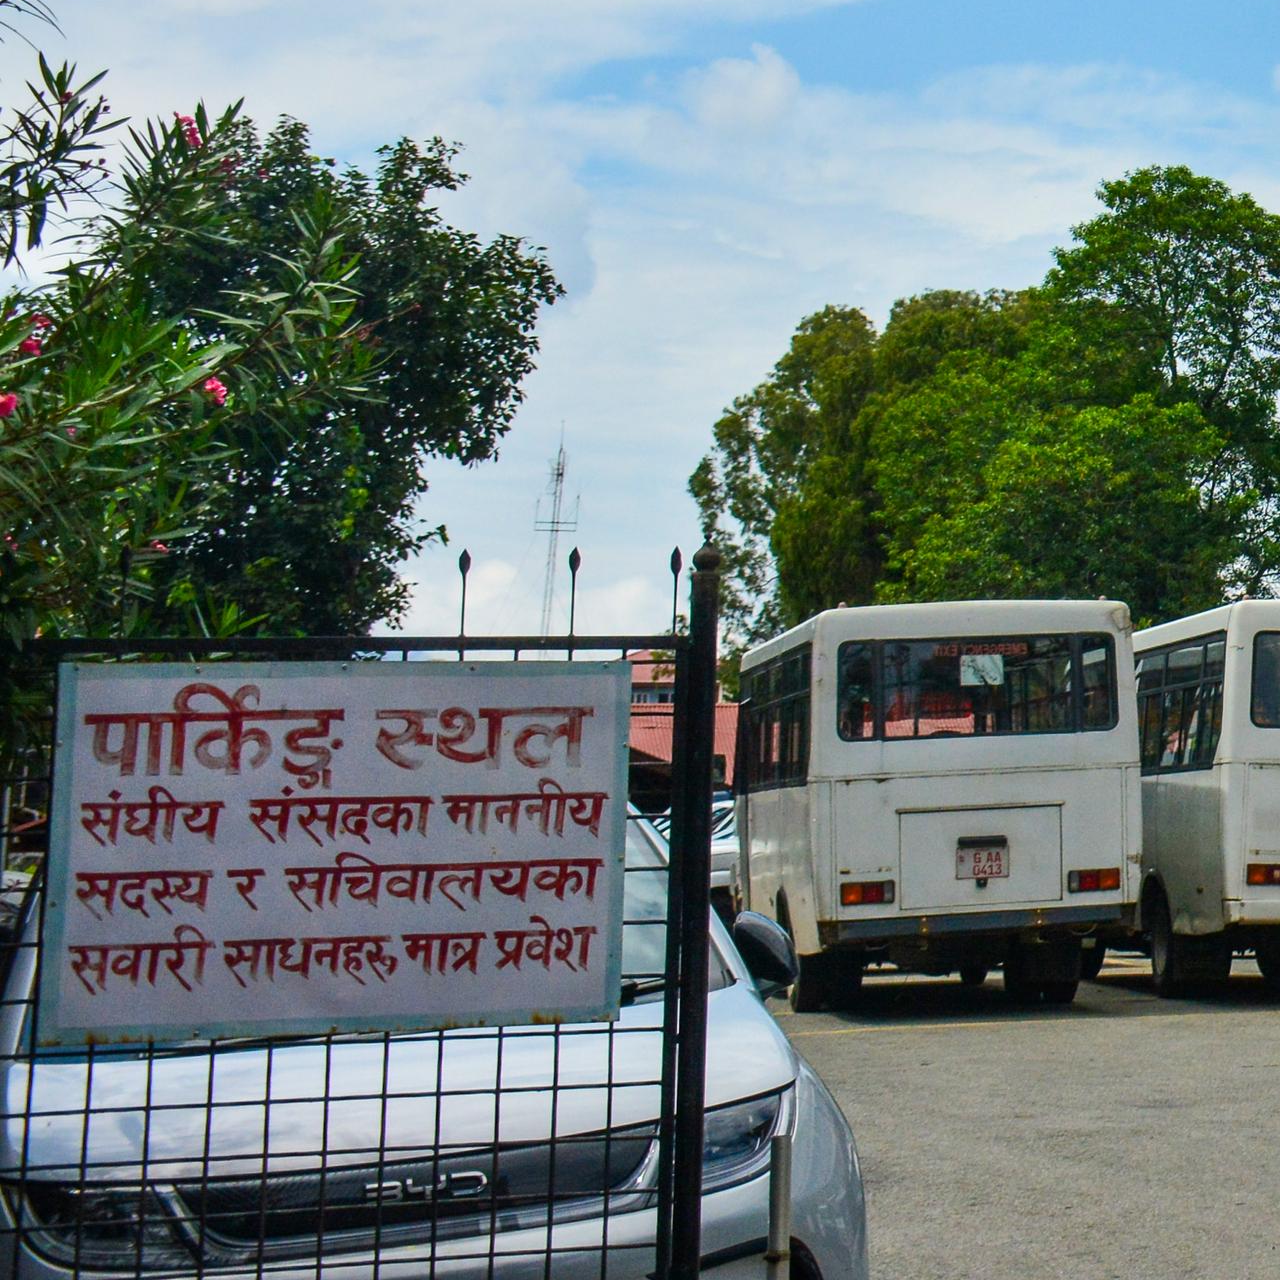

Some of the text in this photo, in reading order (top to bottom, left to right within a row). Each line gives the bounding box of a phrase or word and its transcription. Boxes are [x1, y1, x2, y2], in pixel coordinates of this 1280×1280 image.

[85, 683, 594, 789] पार्किङ्ग स्थल
[81, 778, 609, 847] संघीय संसदका माननीय
[76, 852, 604, 921] सदस्य र सचिवालयका
[68, 924, 216, 995] सवारी
[401, 932, 486, 976] मात्र
[494, 915, 597, 972] प्रवेश
[365, 1171, 488, 1200] BYD
